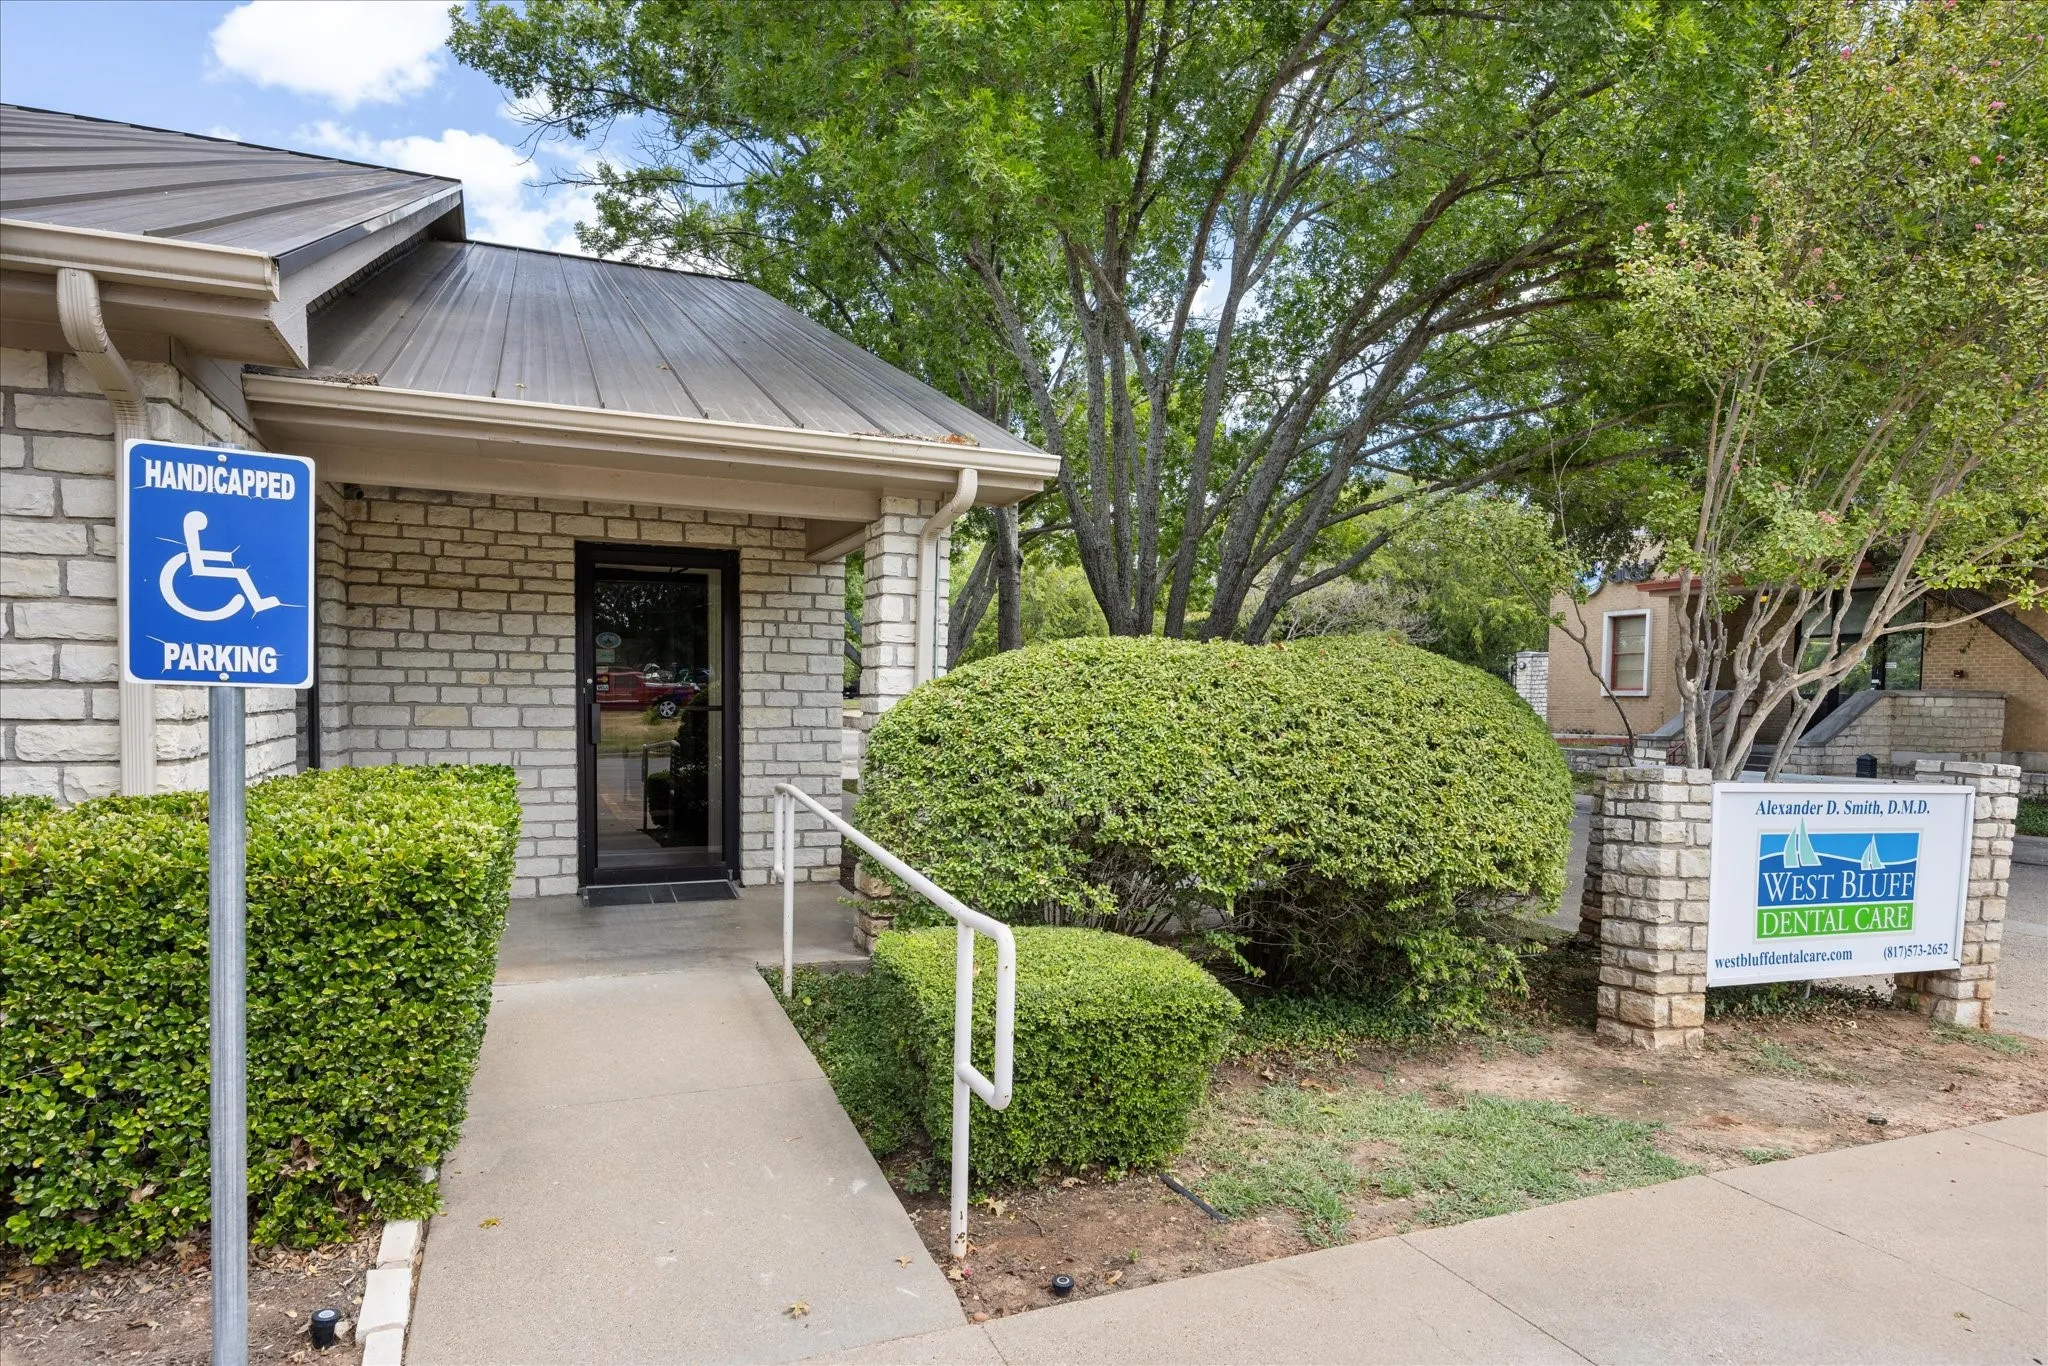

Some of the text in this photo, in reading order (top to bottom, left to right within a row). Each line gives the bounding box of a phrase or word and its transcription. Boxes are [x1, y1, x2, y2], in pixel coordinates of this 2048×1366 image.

[145, 459, 296, 501] HANDICAPPED
[163, 642, 278, 674] PARKING
[1756, 799, 1931, 817] Alexander D. Smith, D.M.D.
[1762, 870, 1914, 902] WEST BLUFF
[1761, 906, 1909, 936] DENTAL CARE
[1714, 943, 1949, 969] westbluffdentalcare.com (817)573-2652
